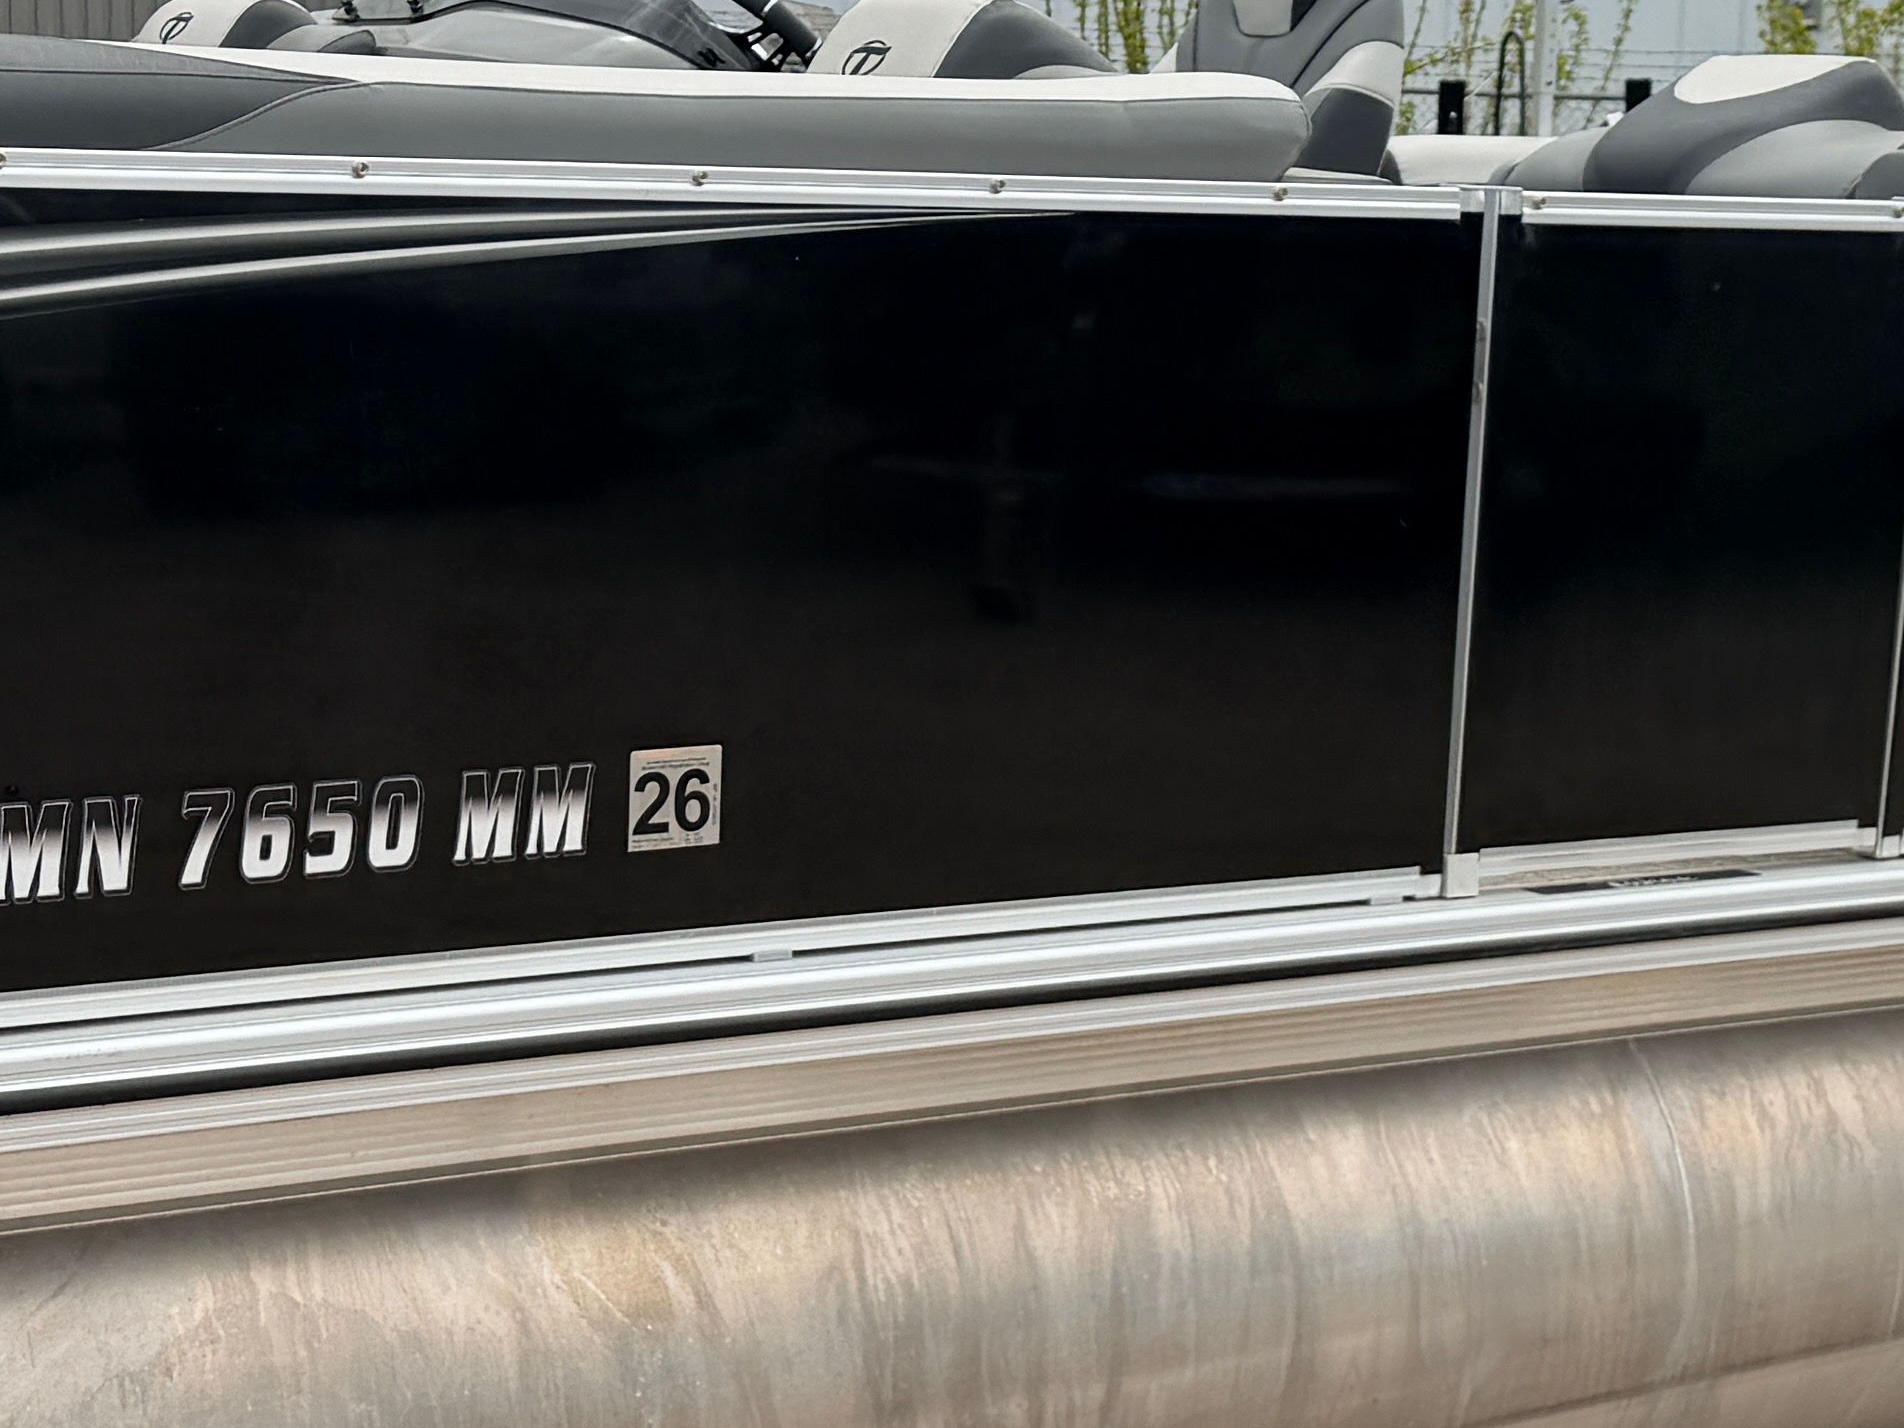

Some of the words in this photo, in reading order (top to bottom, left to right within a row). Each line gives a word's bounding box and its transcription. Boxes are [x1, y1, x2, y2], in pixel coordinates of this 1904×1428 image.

[178, 774, 425, 891] 7650
[451, 761, 597, 867] MM
[632, 768, 711, 837] 26
